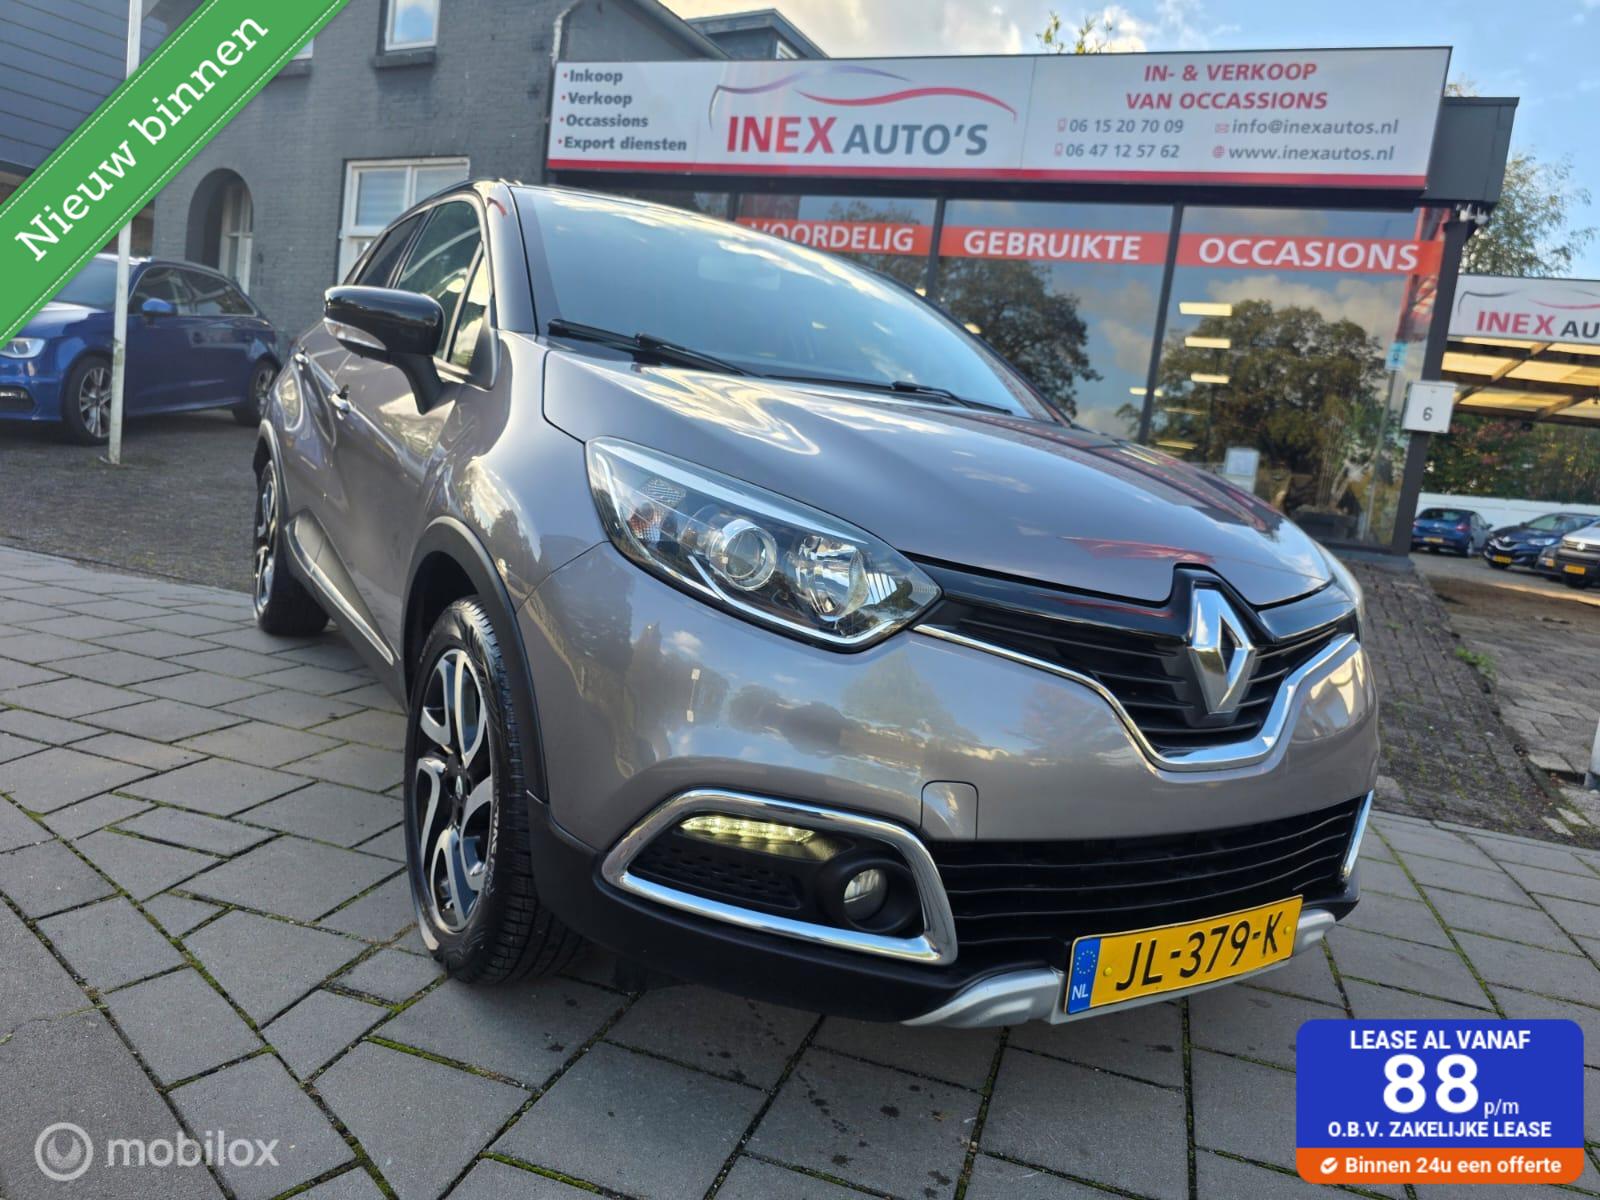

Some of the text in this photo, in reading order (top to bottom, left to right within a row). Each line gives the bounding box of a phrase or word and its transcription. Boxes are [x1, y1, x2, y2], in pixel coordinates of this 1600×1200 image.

[569, 69, 623, 86] Inkoop
[1144, 63, 1317, 81] IN- & VERKOOP
[568, 91, 632, 108] Verkoop
[1126, 92, 1328, 110] VAN OCCASSIONS
[566, 113, 649, 128] Occassions
[1069, 119, 1184, 134] 06 15 20 70 09
[1232, 118, 1400, 135] info@inexautos.nl
[564, 136, 687, 152] Export diensten
[726, 116, 989, 156] INEX AUTO'S
[1065, 143, 1180, 159] 06 47 12 57 62
[1228, 145, 1396, 161] www.inexautos.nl
[963, 229, 1143, 262] GEBRUIKTE
[1198, 237, 1420, 271] OCCASIONS
[1475, 310, 1556, 337] INEX
[1422, 407, 1434, 422] 6
[1115, 911, 1283, 993] JL-379-K
[1071, 983, 1089, 1001] NL
